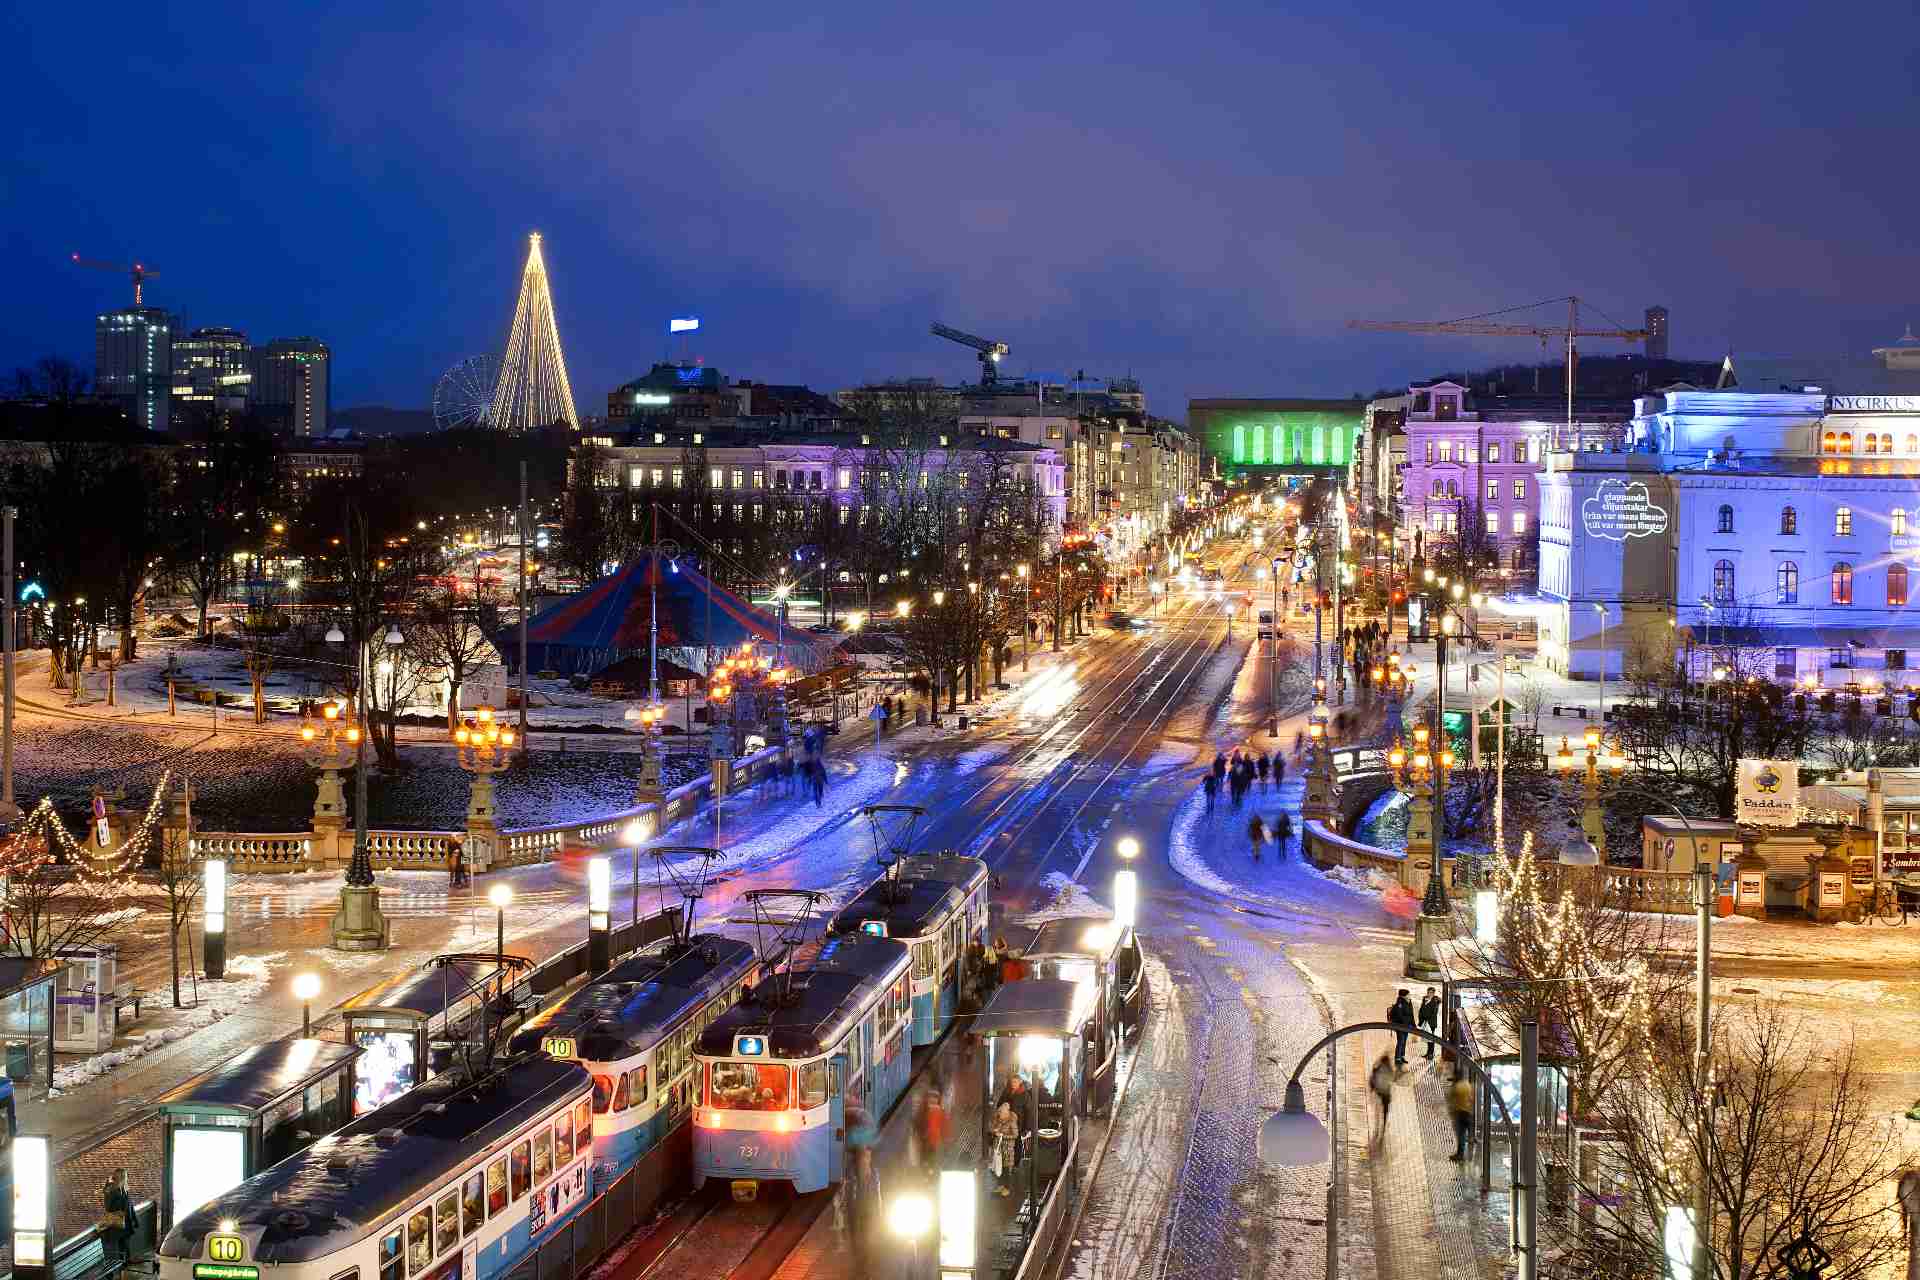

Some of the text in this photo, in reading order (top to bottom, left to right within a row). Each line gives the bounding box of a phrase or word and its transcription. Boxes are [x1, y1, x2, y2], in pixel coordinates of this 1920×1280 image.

[1834, 397, 1914, 409] NYCIRKUS
[1743, 798, 1792, 809] Paddan
[550, 1040, 567, 1055] 10
[215, 1239, 238, 1260] 10
